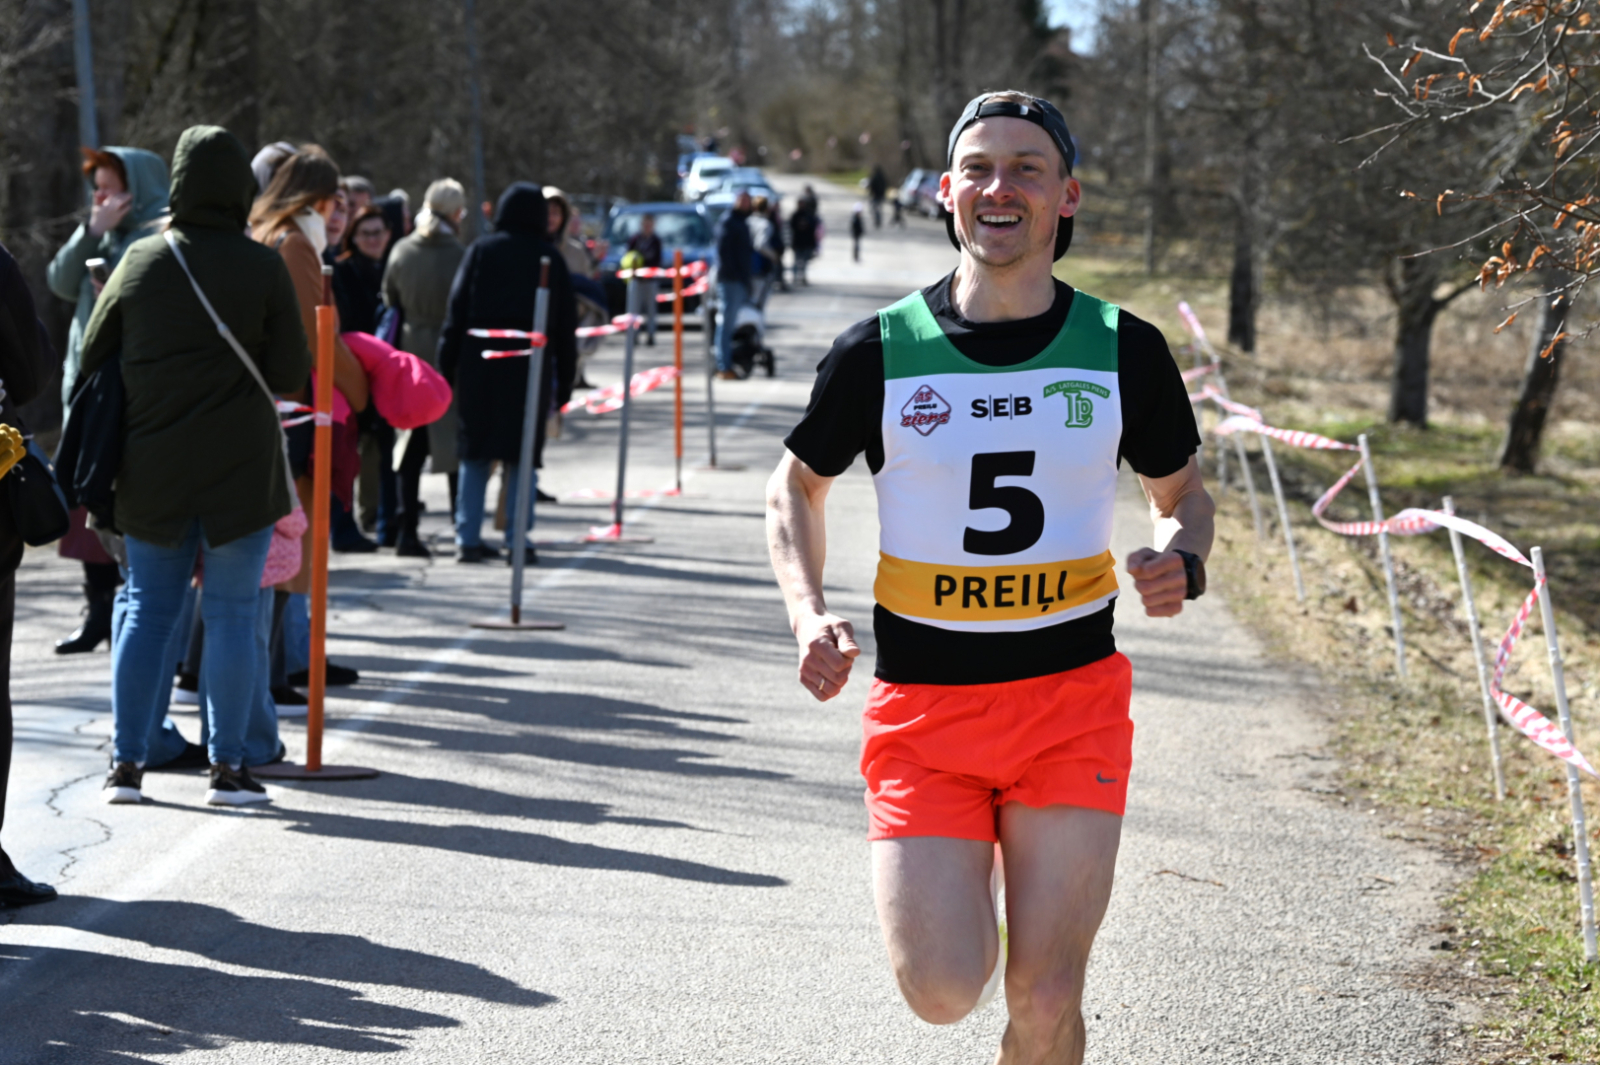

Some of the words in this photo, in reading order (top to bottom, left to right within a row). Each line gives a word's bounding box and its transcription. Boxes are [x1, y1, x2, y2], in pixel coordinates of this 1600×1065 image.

[1058, 381, 1091, 391] LATGALES
[1091, 385, 1108, 397] PIENS
[963, 450, 1045, 556] 5
[934, 570, 1068, 612] PREIĻI
